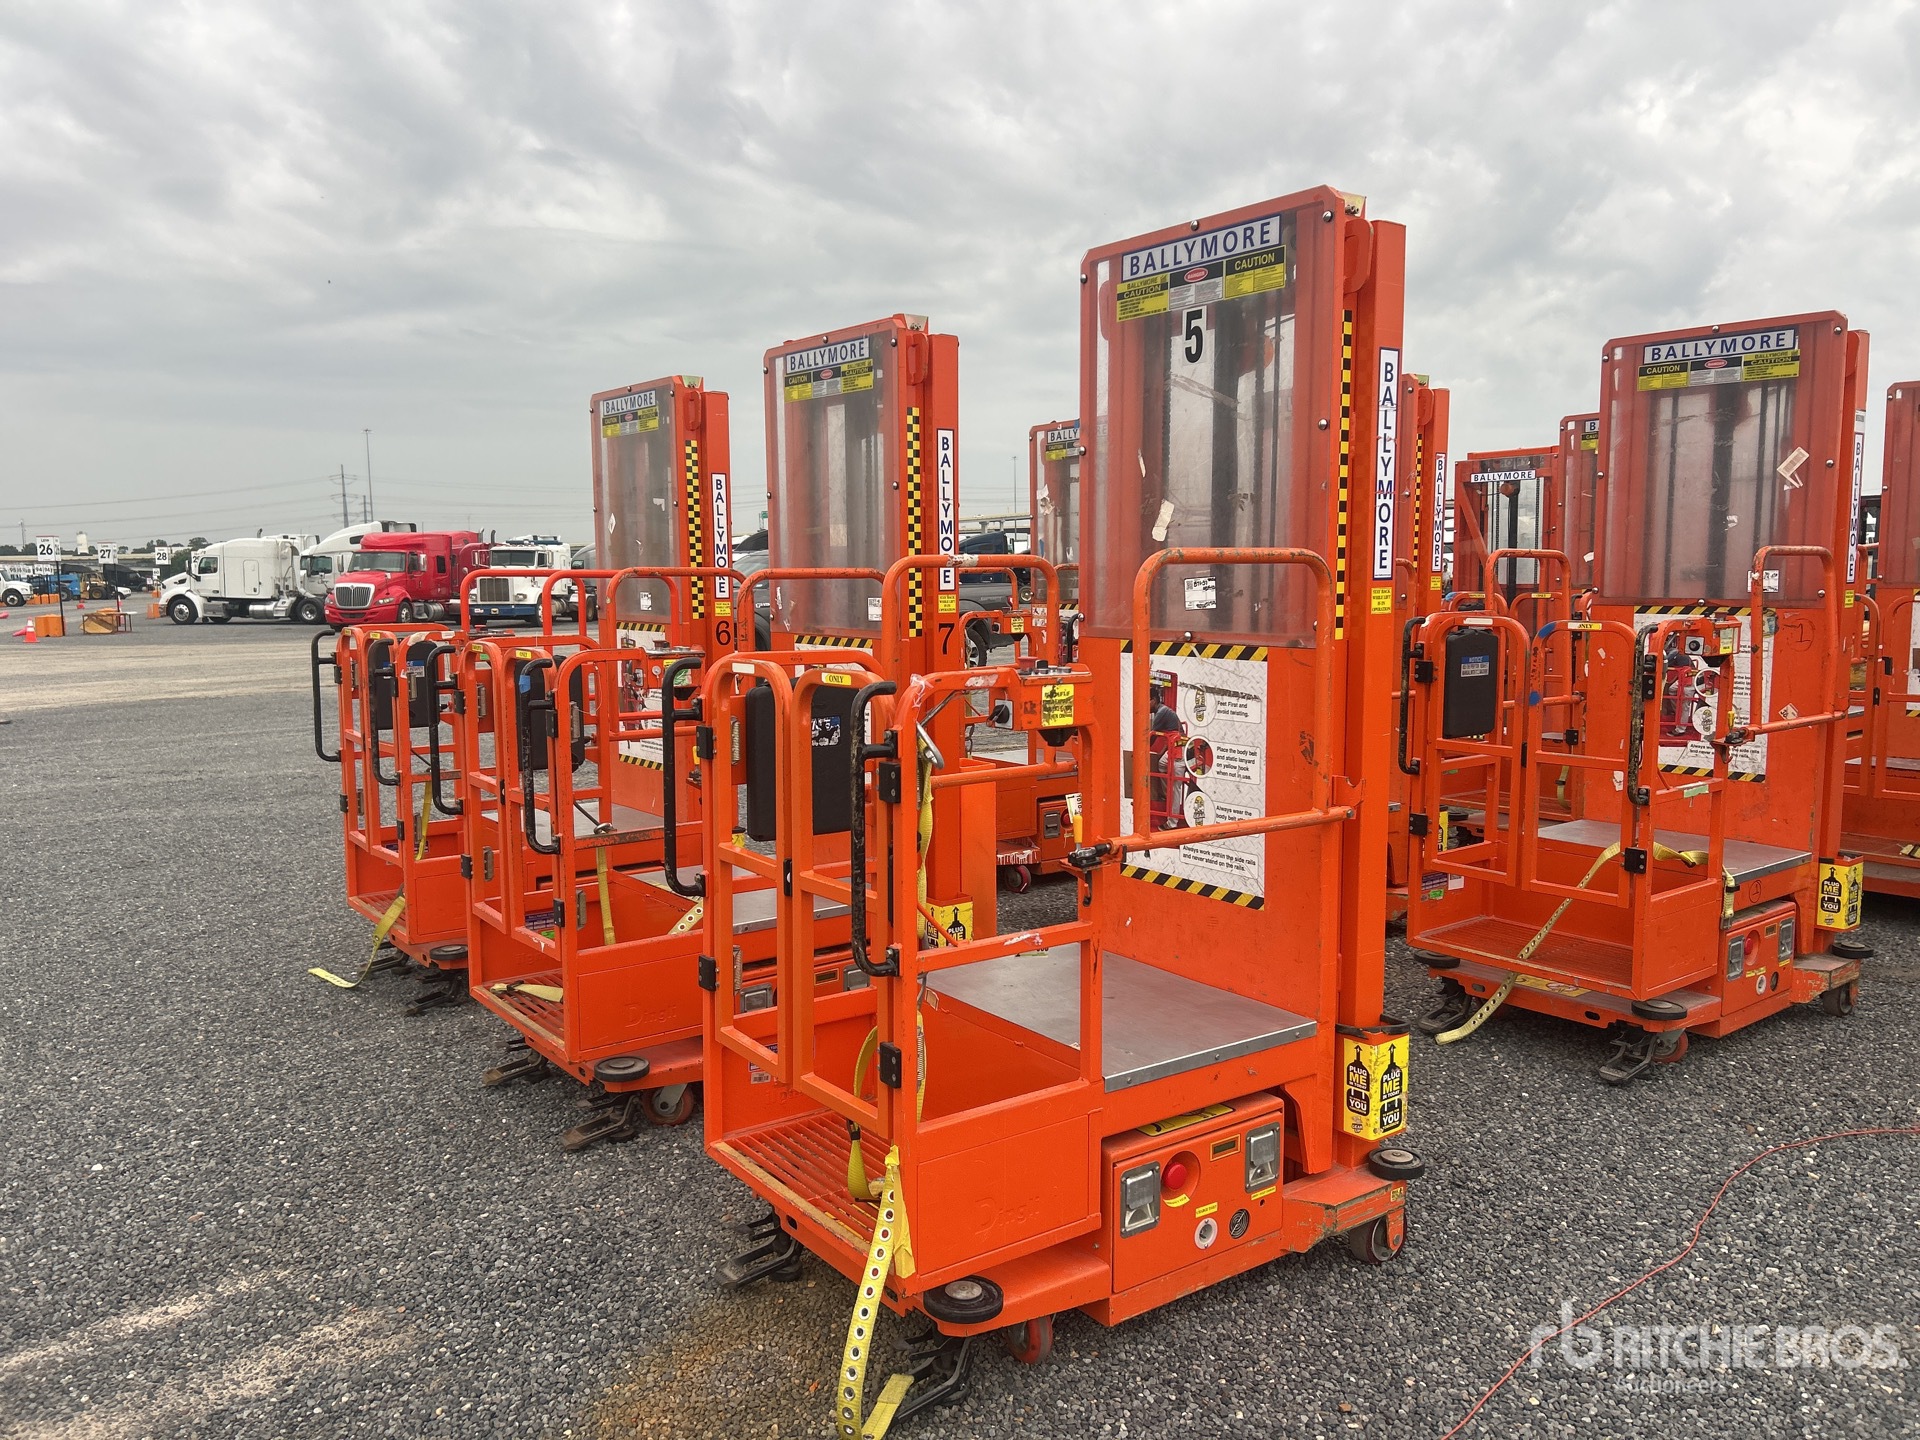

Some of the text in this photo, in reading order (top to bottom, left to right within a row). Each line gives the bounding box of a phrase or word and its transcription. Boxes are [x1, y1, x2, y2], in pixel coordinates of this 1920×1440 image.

[1130, 221, 1271, 276] BALLYMORE
[1235, 252, 1275, 271] CAUTION
[1123, 284, 1162, 299] CAUTION
[1185, 309, 1204, 363] 5
[1651, 332, 1786, 362] BALLYMORE
[790, 341, 865, 371] BALLYMORE
[1751, 357, 1792, 366] CAUTION
[845, 366, 869, 376] CAUTION
[1646, 364, 1680, 375] CAUTION
[788, 375, 808, 385] CAUTION
[605, 392, 653, 414] BALLYMORE
[1377, 362, 1394, 569] BALLYMORE
[1473, 470, 1533, 482] BALLYMORE
[940, 436, 953, 583] BALLYMOE
[1434, 459, 1444, 567] BALLYMORE
[39, 544, 53, 555] 26
[100, 549, 111, 559] 27
[156, 552, 167, 561] 28
[716, 620, 731, 646] 6
[938, 622, 955, 655] 7
[828, 674, 844, 684] ONLY
[1237, 748, 1248, 756] body
[1216, 805, 1232, 813] Always
[1183, 845, 1199, 854] Always
[1245, 858, 1256, 866] rails
[1824, 885, 1839, 893] ME
[928, 925, 937, 935] ME
[948, 926, 964, 934] PLUG
[1349, 1065, 1367, 1076] PLUG
[1382, 1070, 1400, 1082] PLUG
[1349, 1072, 1367, 1086] ME
[1382, 1078, 1400, 1095] ME
[1388, 1090, 1400, 1098] TODAY
[1349, 1098, 1367, 1111] YOU
[1382, 1111, 1400, 1126] YOU
